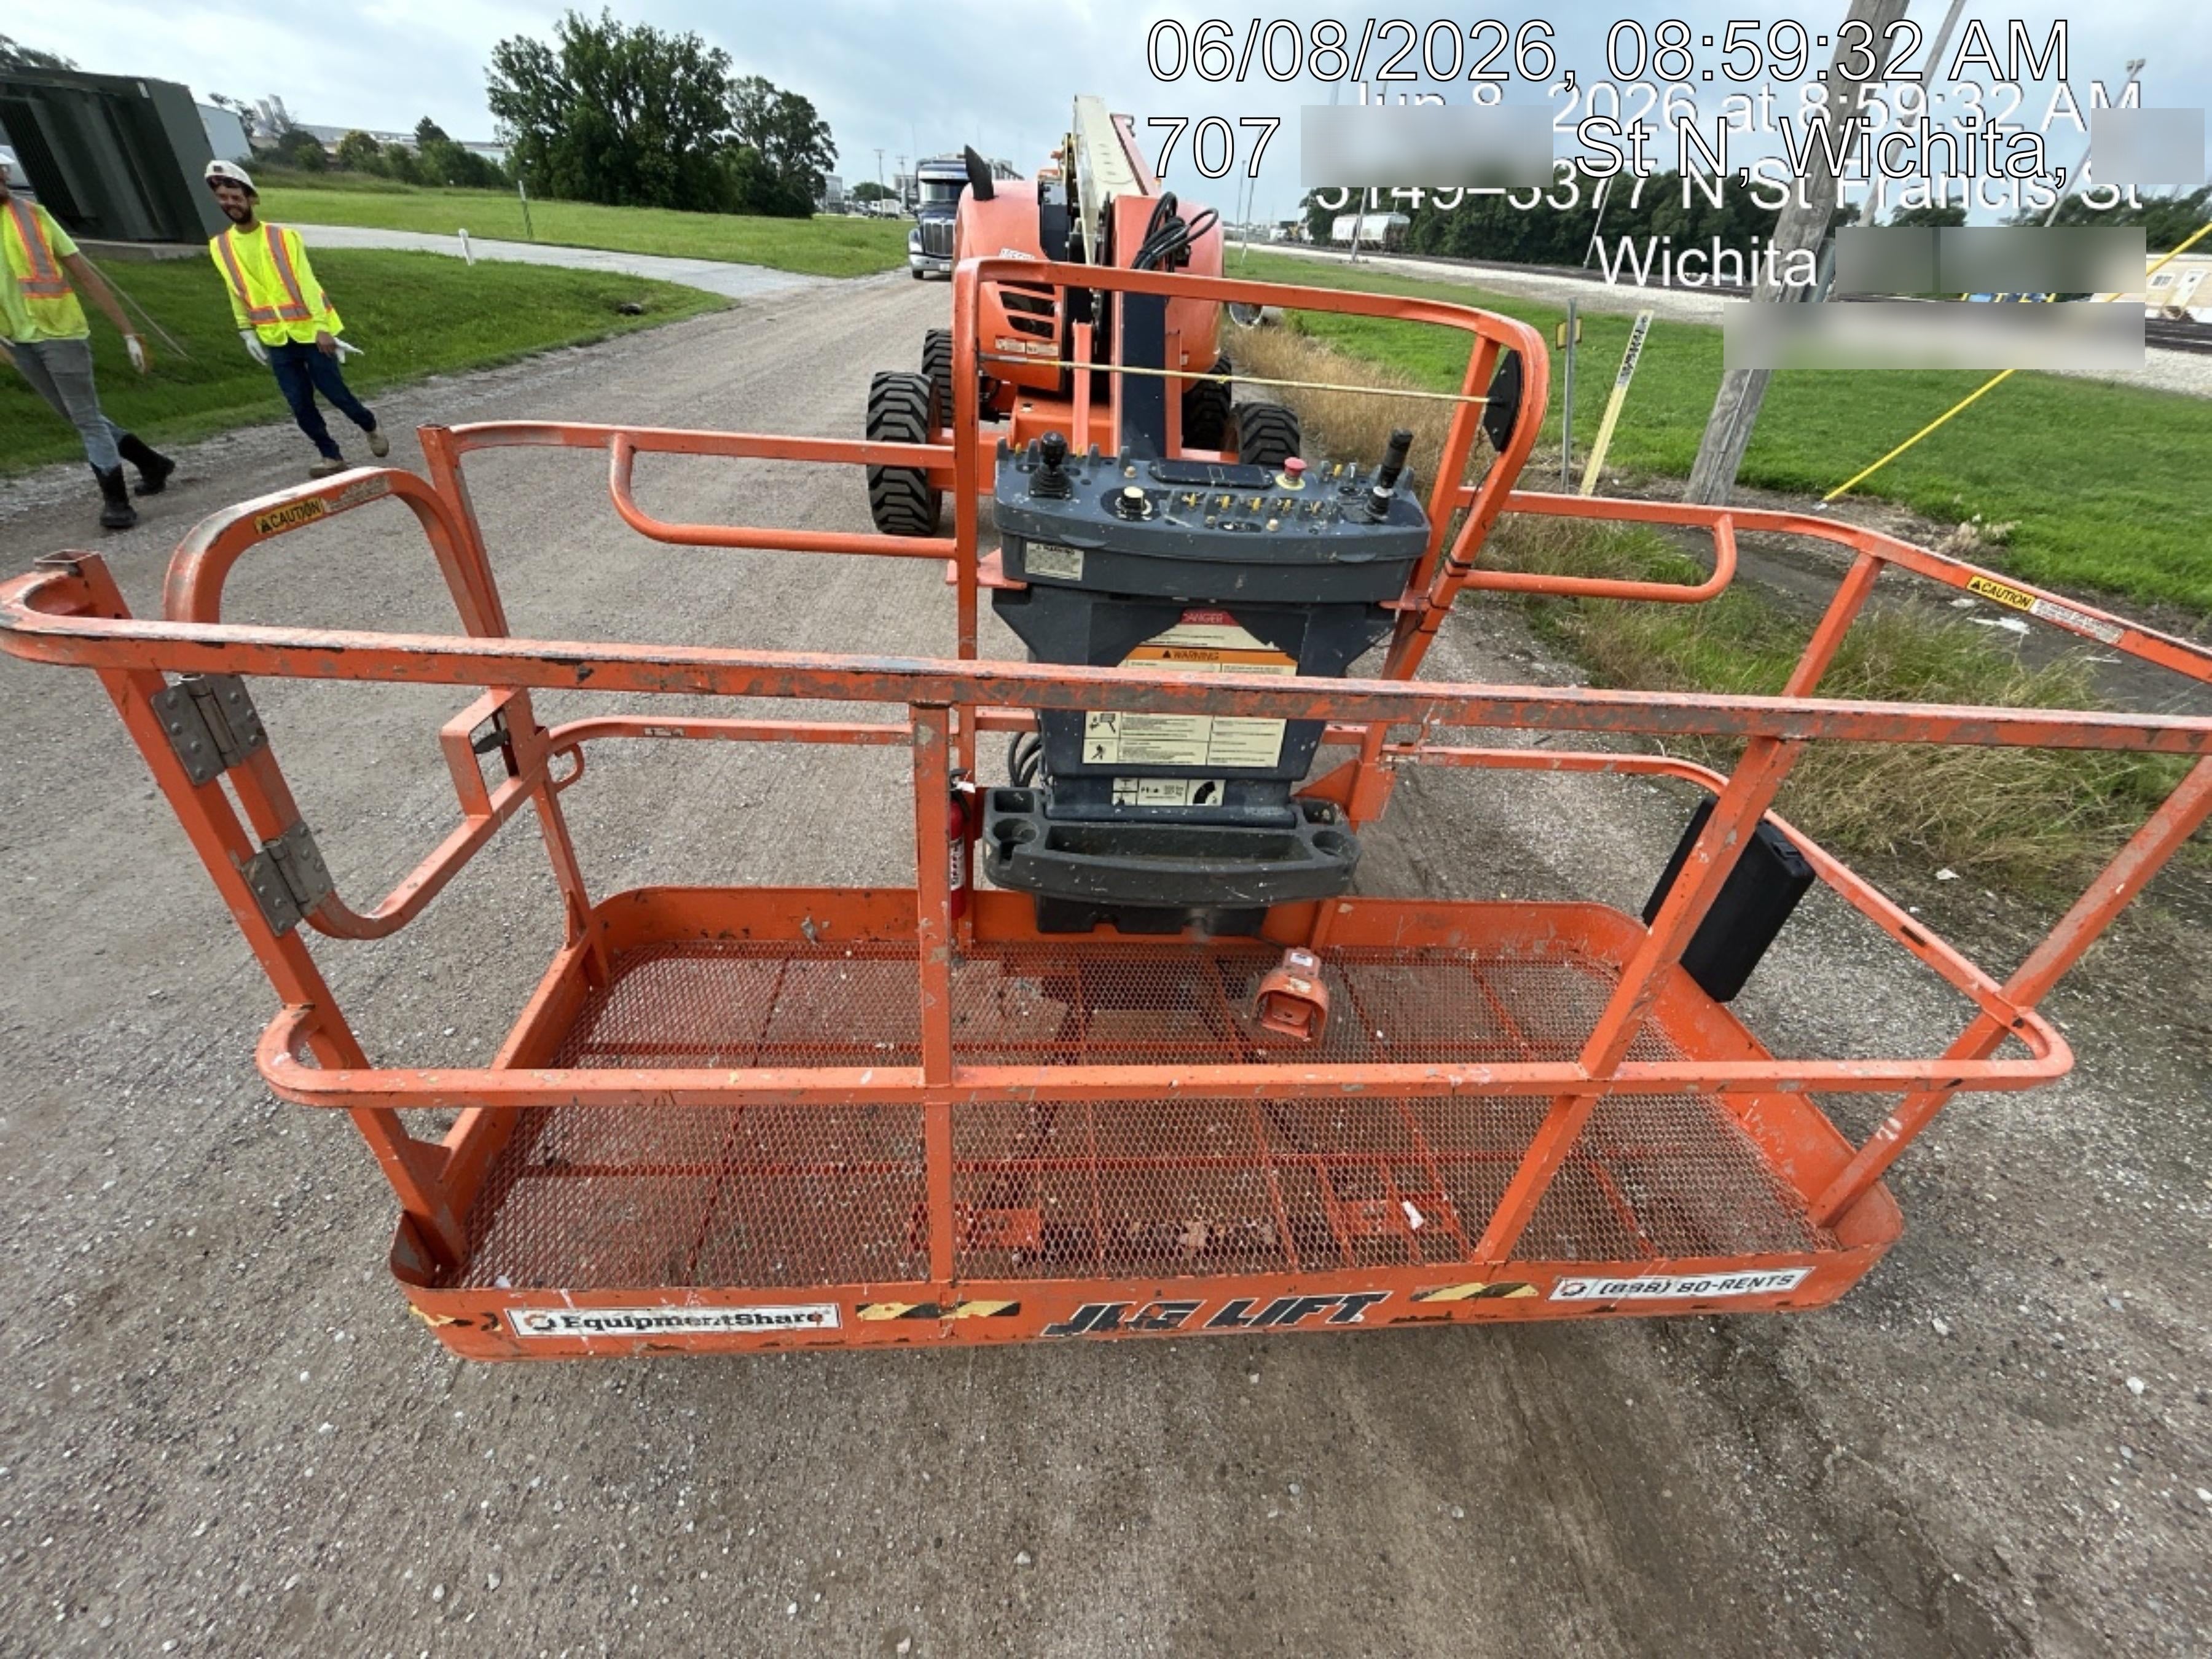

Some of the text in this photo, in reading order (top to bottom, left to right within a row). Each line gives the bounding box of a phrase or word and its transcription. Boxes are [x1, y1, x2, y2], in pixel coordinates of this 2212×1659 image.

[272, 500, 321, 528] CAUTION
[1980, 583, 2031, 607] CAUTION
[1173, 650, 1219, 661] WARNING
[1677, 1275, 1795, 1293] 80-RENTS
[1202, 1291, 1394, 1328] LIFT
